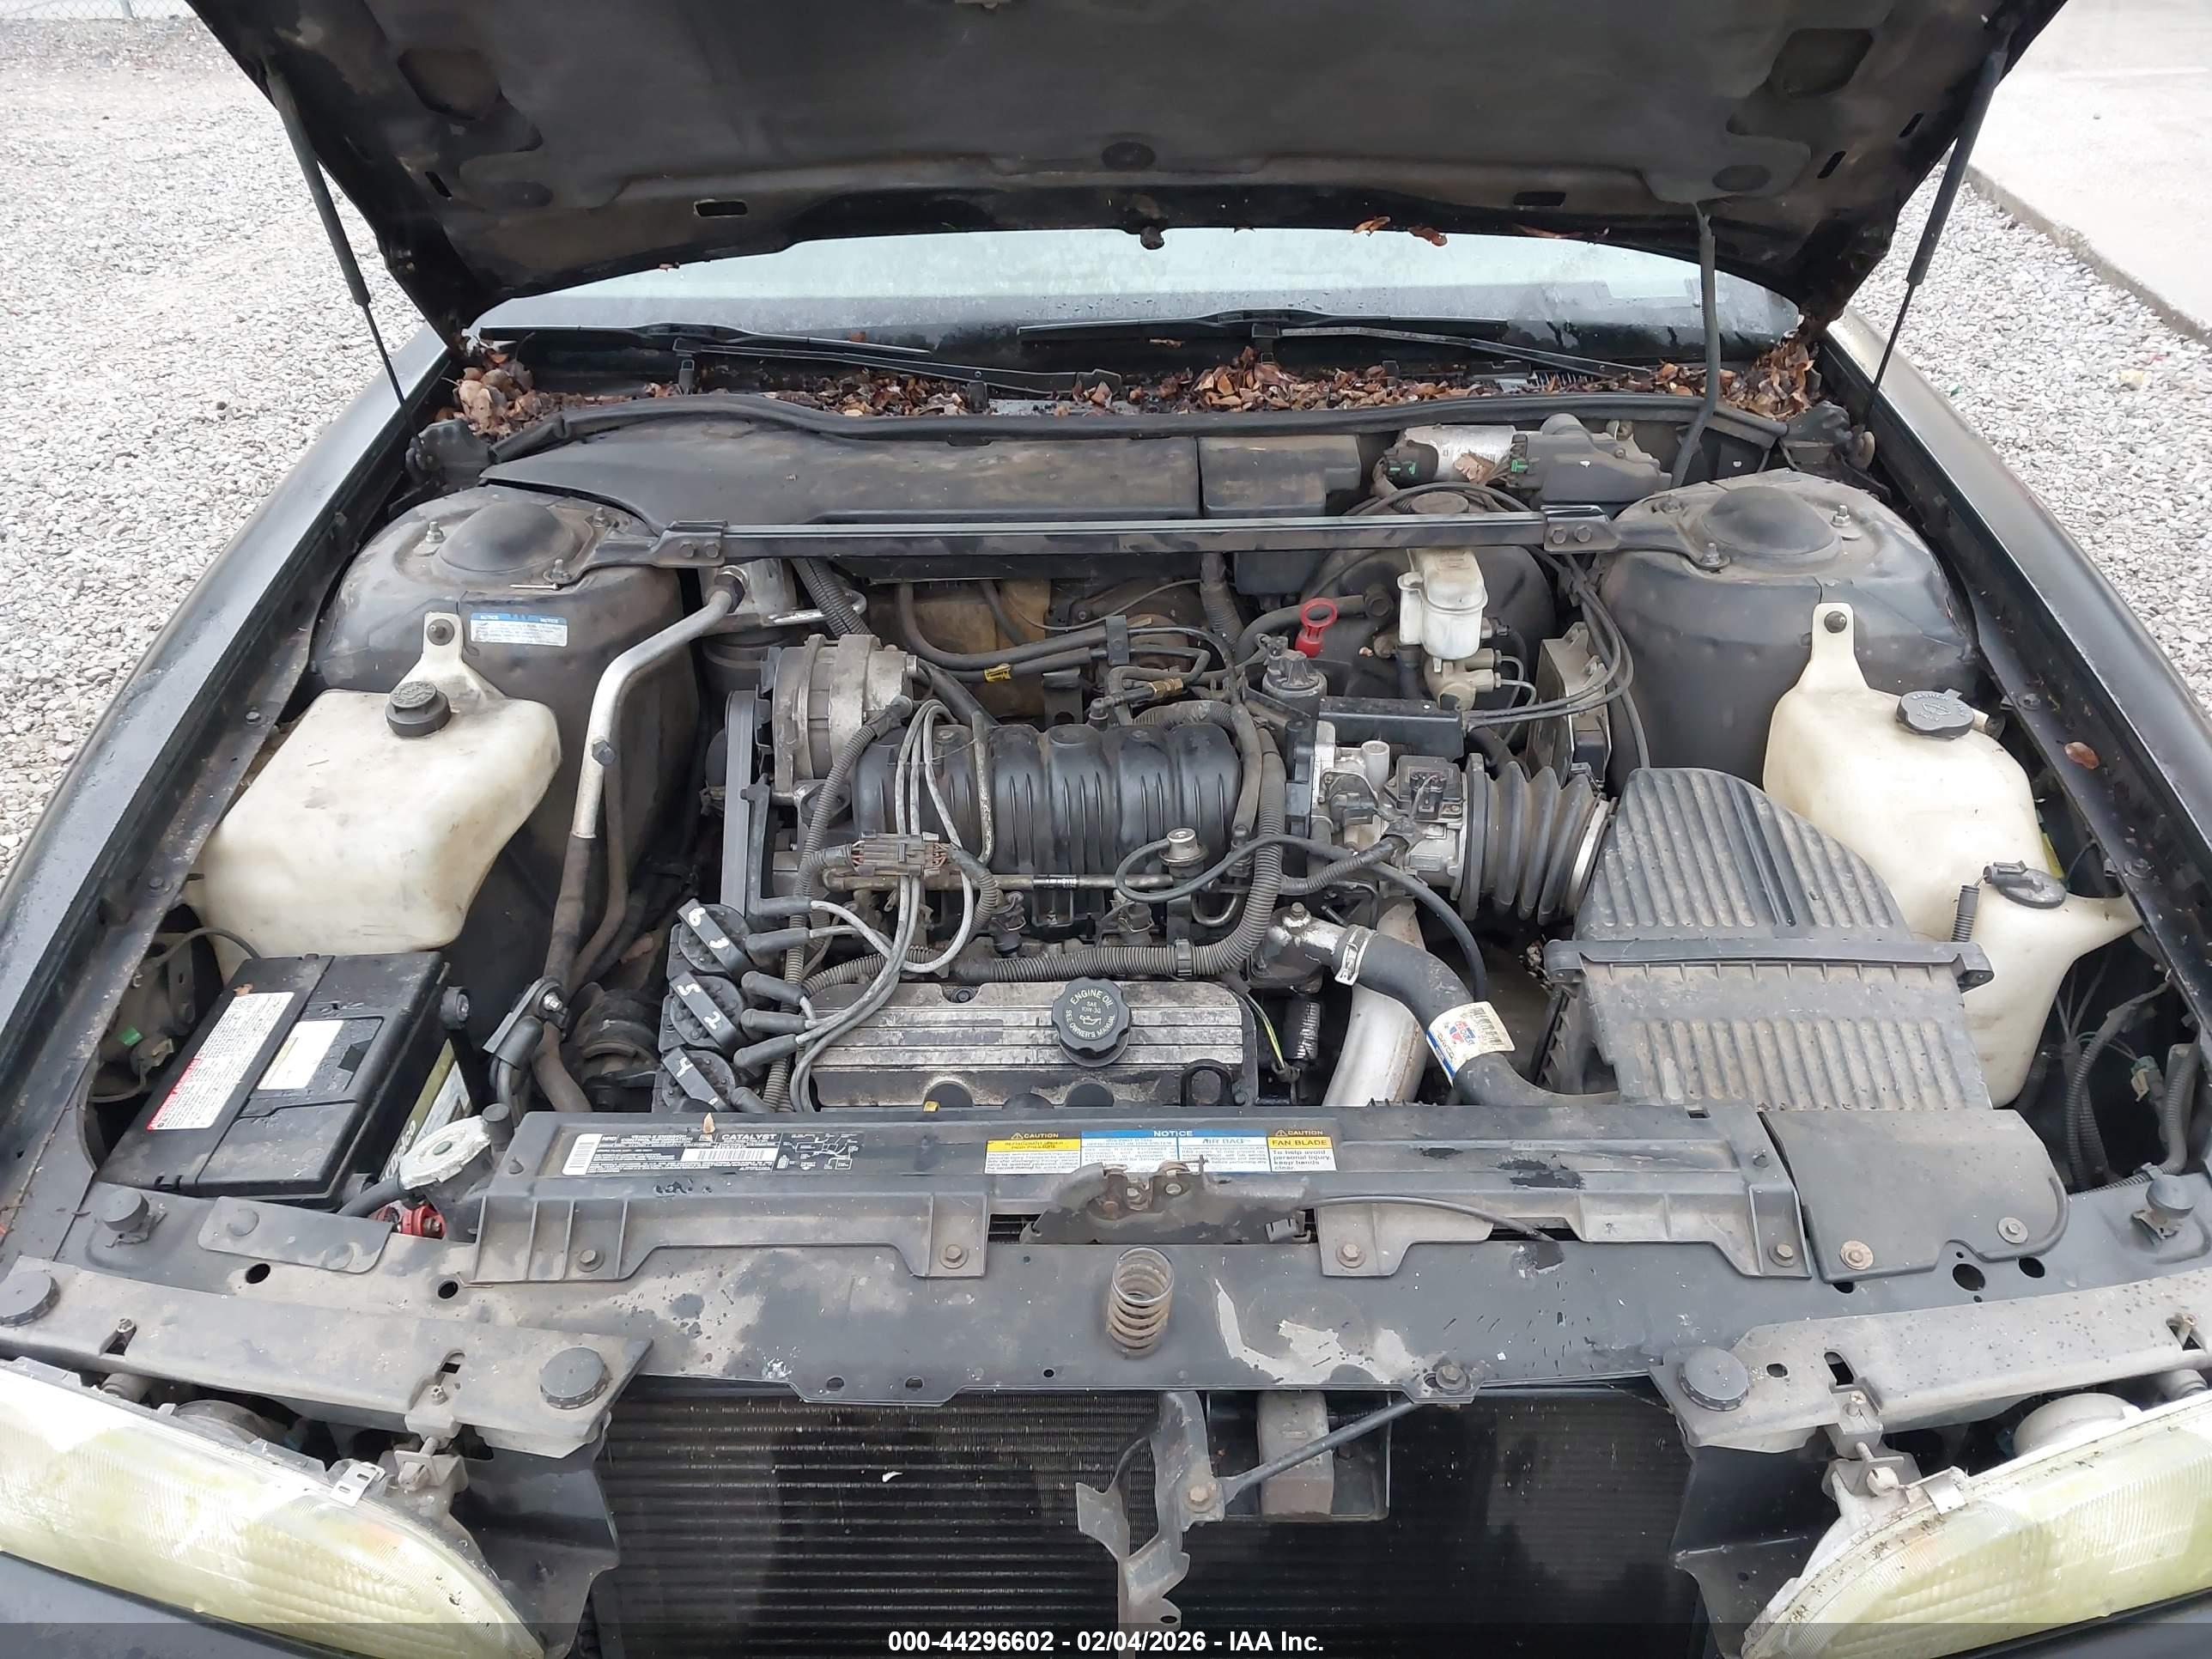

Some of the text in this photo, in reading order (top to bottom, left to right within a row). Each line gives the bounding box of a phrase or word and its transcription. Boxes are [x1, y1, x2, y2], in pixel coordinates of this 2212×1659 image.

[688, 907, 706, 927] 6
[678, 983, 702, 995] 5
[1070, 988, 1114, 1009] ENGINE OIL
[704, 1011, 721, 1030] 2
[1069, 1023, 1096, 1038] OWNER'S
[1097, 1014, 1115, 1037] MANUAL
[677, 1056, 694, 1078] 4
